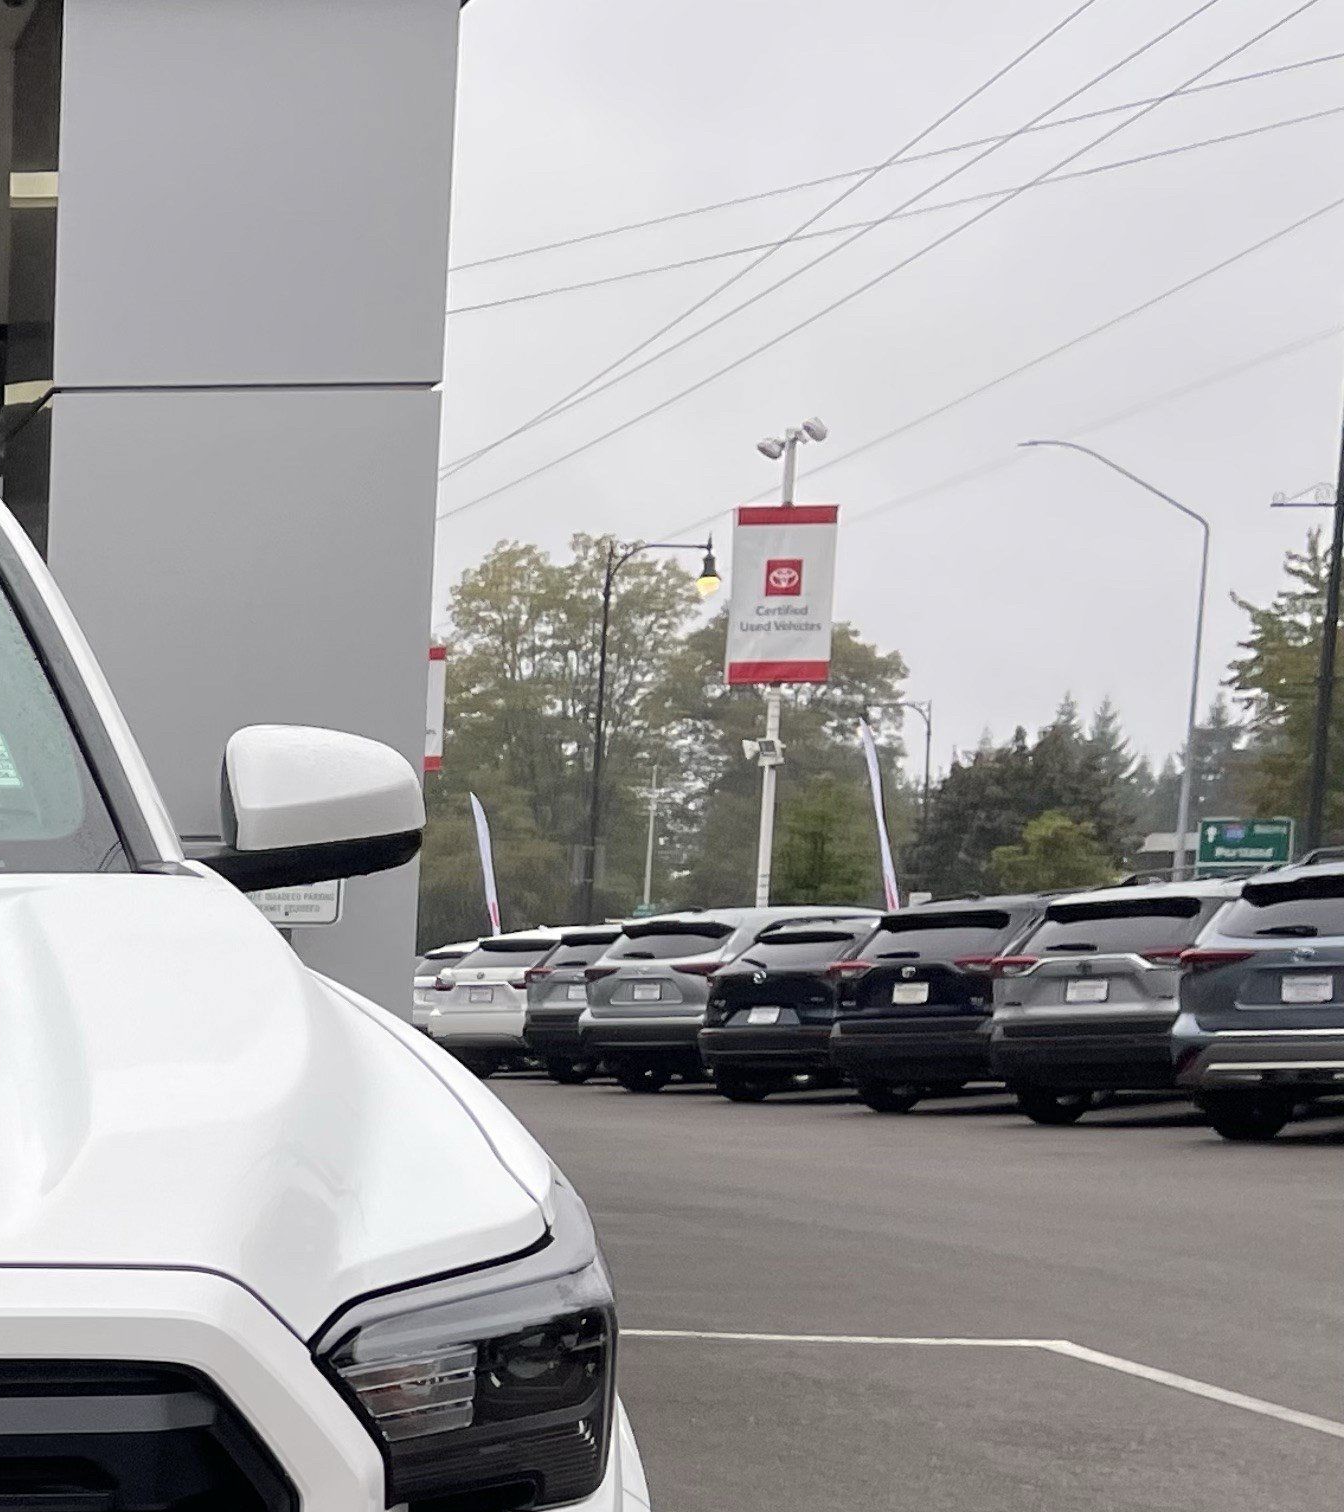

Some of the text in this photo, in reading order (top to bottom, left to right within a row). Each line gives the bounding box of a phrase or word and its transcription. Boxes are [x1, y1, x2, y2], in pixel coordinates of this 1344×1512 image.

[755, 604, 809, 617] Certified
[739, 621, 823, 632] Used Vehicles
